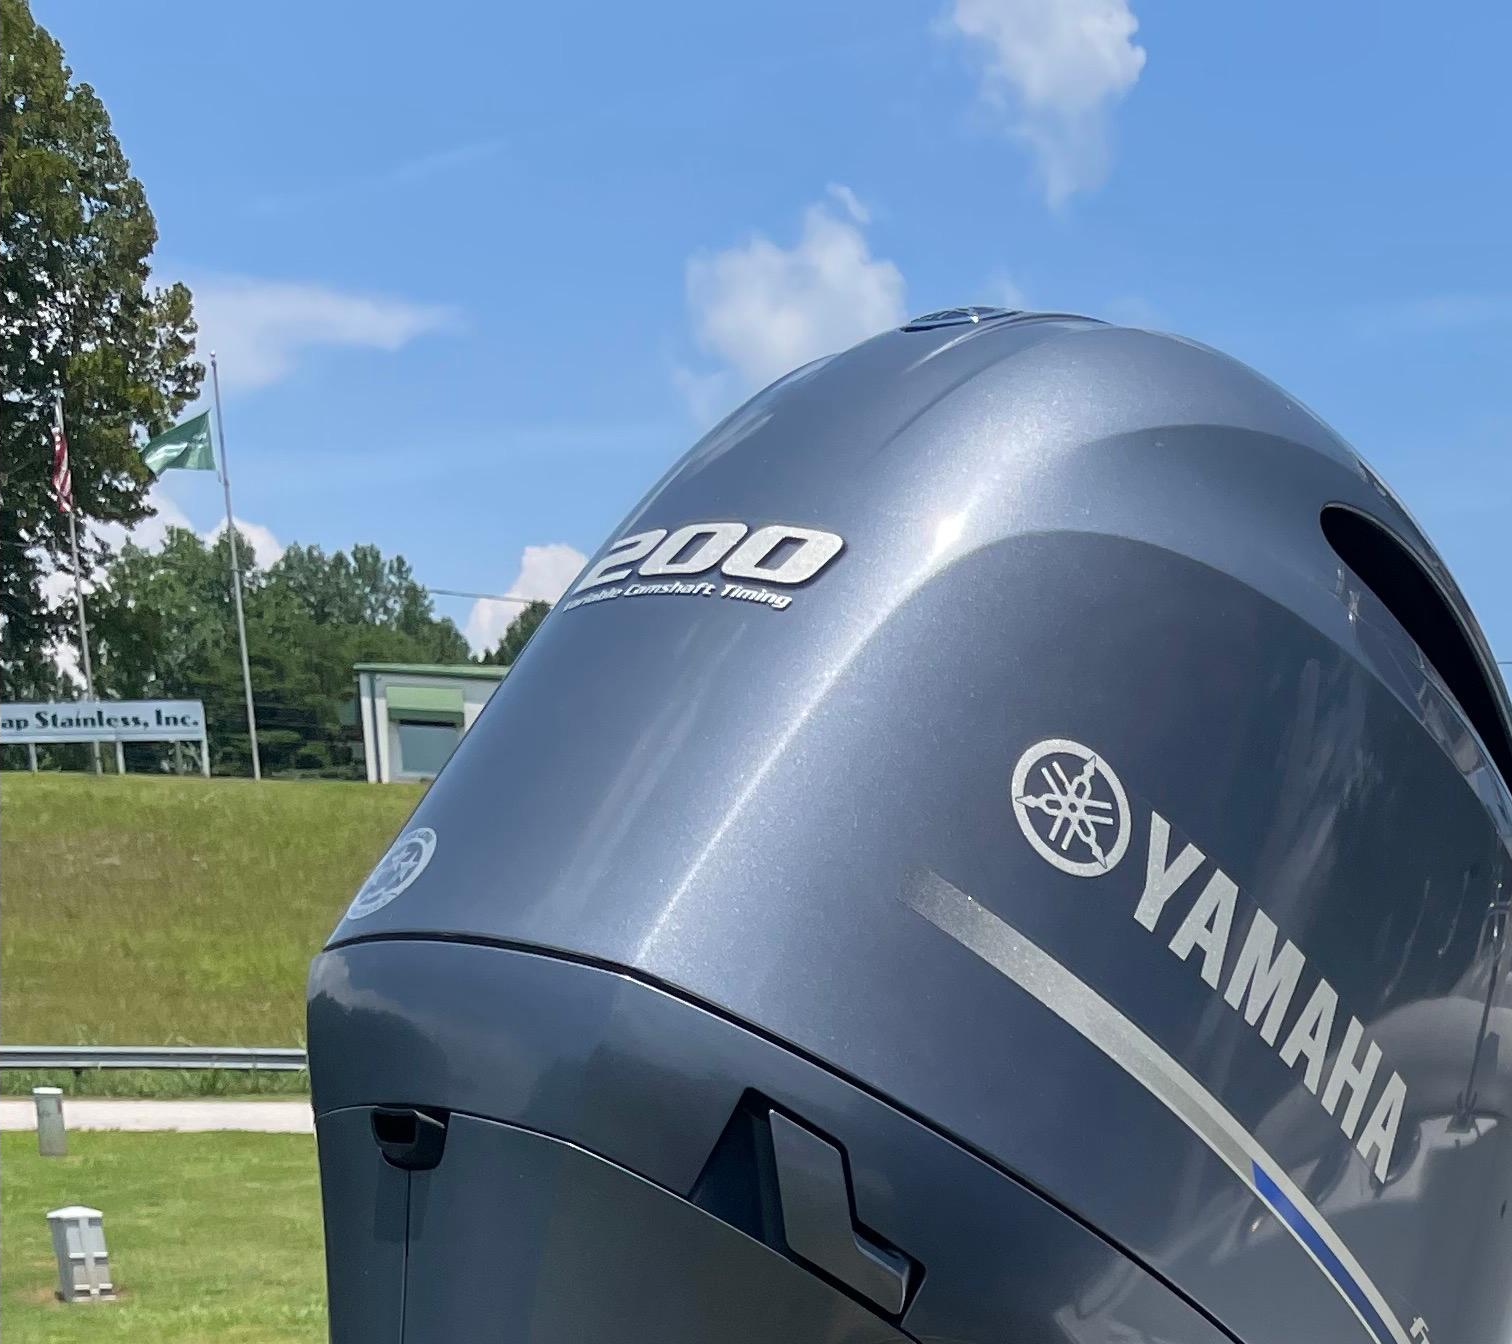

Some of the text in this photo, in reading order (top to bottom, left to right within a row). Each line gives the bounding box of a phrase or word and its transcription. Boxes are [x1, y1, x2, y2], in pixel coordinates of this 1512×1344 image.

[570, 522, 844, 596] 200
[623, 581, 717, 598] Camshaft
[720, 584, 793, 610] Timing
[34, 709, 149, 731] Stainless,
[154, 708, 199, 727] Inc.
[1133, 811, 1408, 1184] YAMAHA
